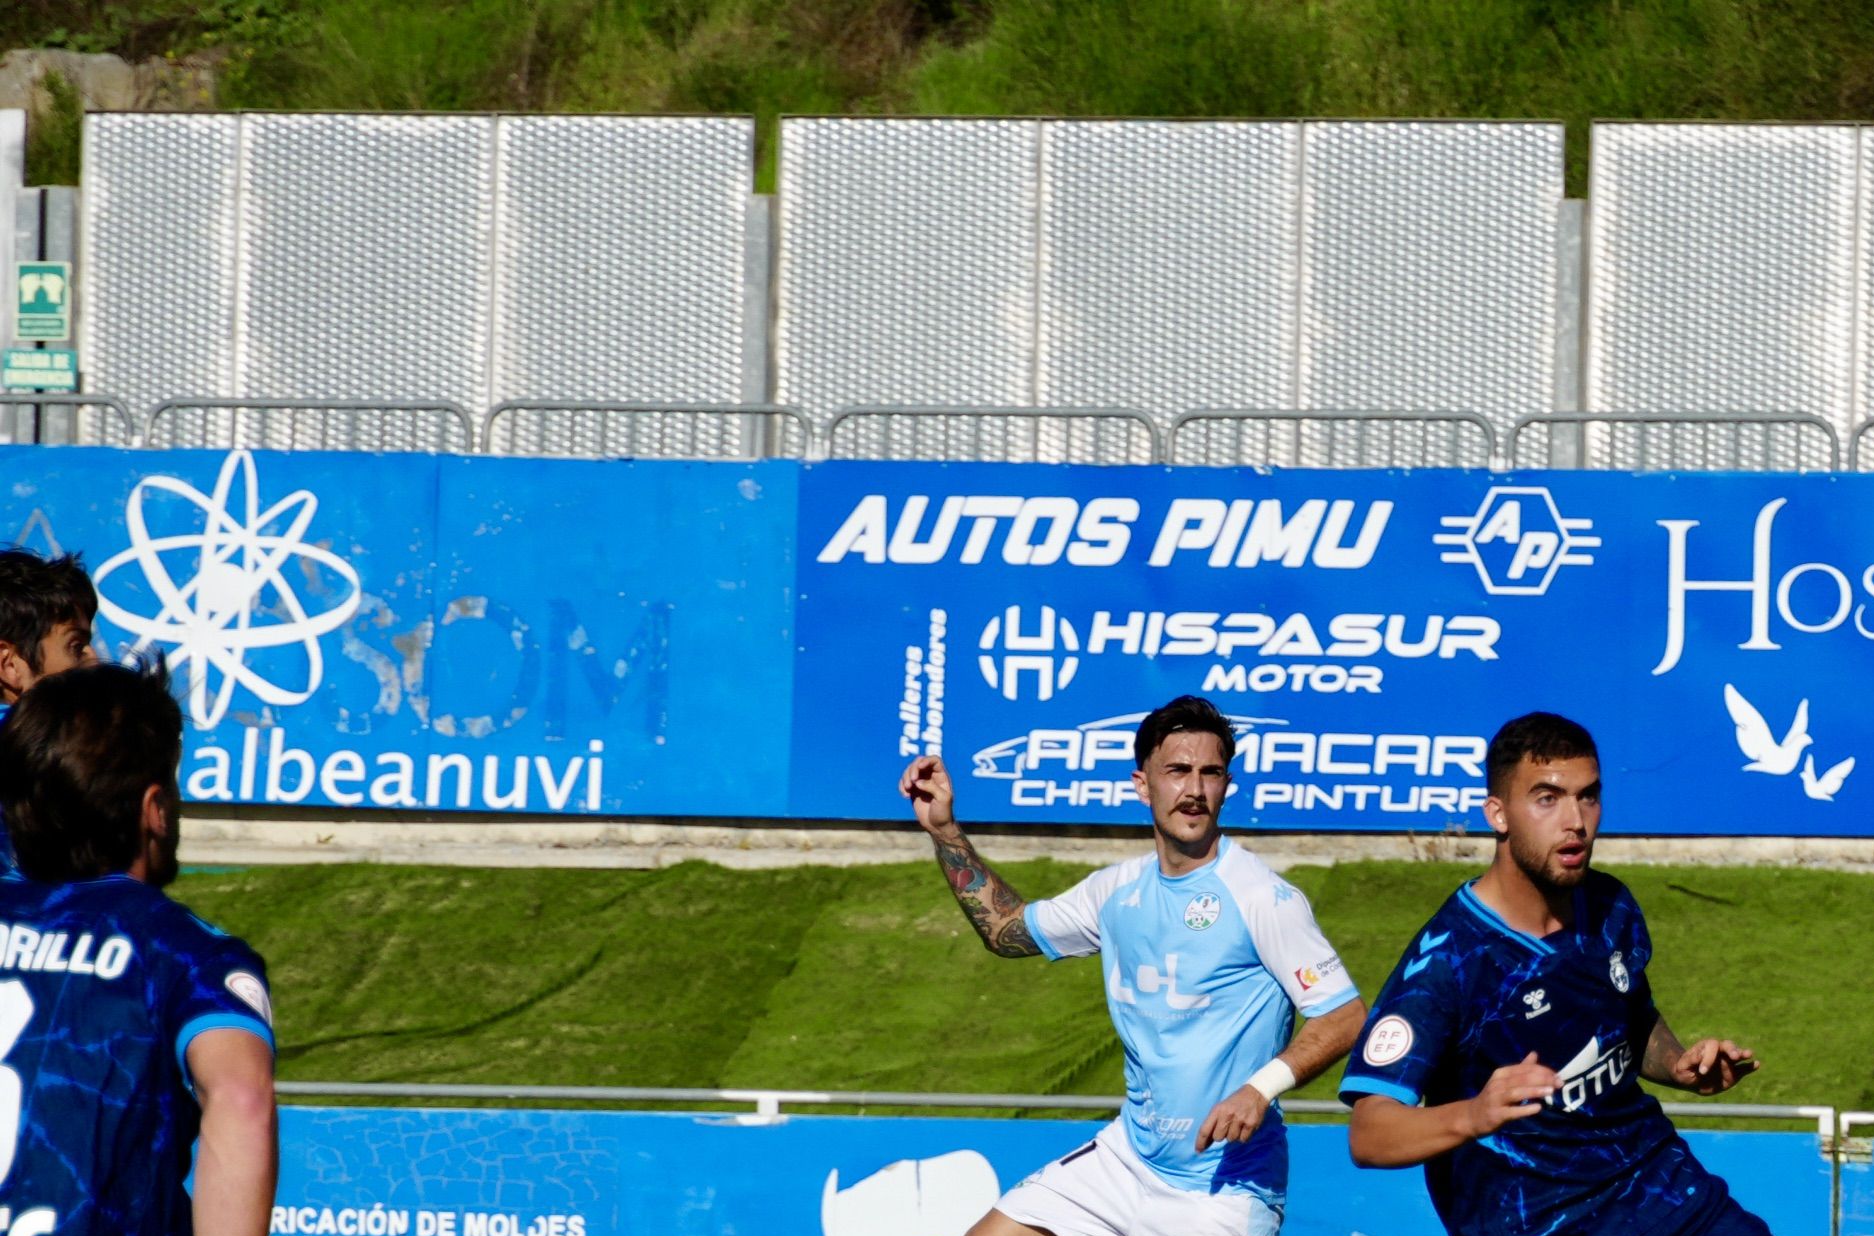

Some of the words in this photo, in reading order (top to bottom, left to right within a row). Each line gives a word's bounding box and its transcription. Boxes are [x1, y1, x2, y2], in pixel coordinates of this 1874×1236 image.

[817, 495, 1140, 566] AUTOS
[1149, 498, 1393, 568] PIMU
[1087, 611, 1501, 660] HISPASUR
[899, 645, 923, 757] Talleres
[921, 608, 947, 759] aboradores
[1202, 664, 1383, 693] MOTOR
[187, 726, 603, 811] albeanuvi
[1011, 779, 1145, 807] CHAP
[269, 1202, 409, 1236] RICACIÓN
